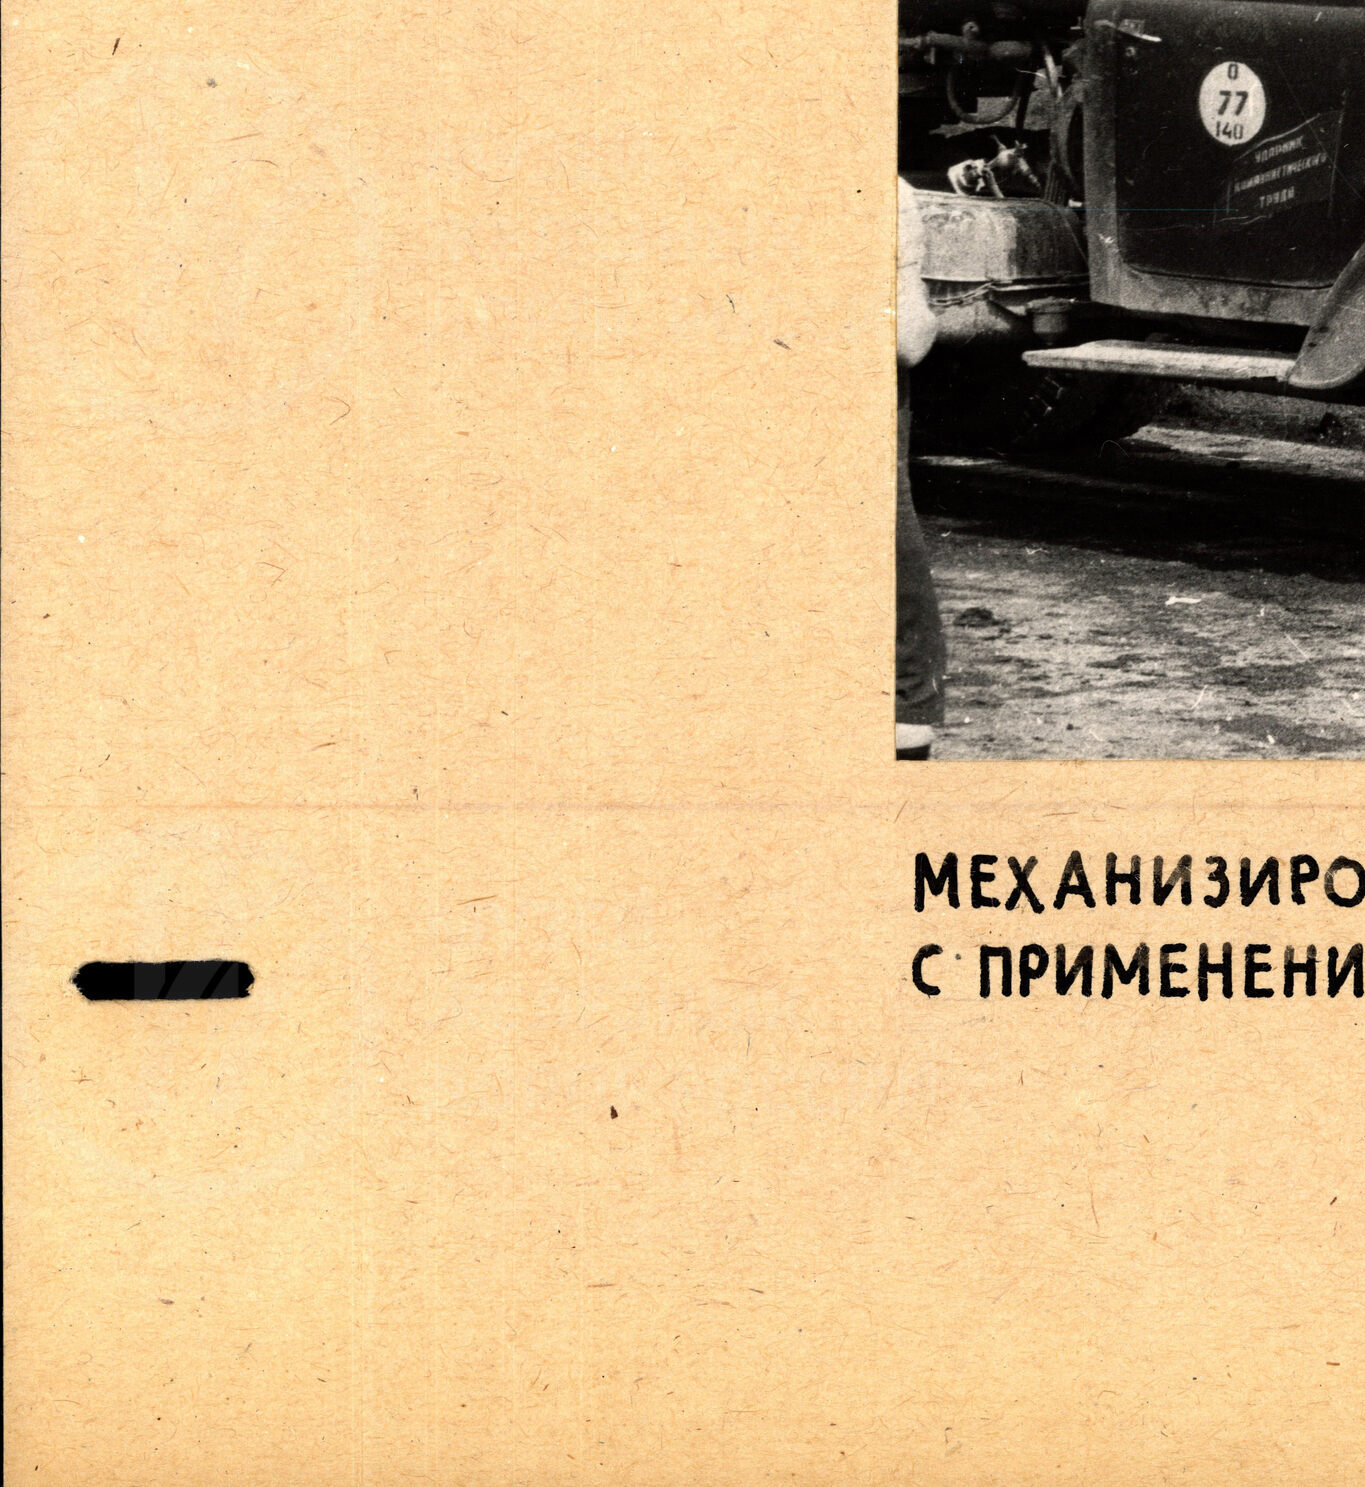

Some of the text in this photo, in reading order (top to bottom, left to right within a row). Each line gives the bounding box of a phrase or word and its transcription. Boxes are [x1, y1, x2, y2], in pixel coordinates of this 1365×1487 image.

[1218, 90, 1249, 116] 77
[1216, 120, 1244, 140] 140
[911, 943, 944, 999] С
